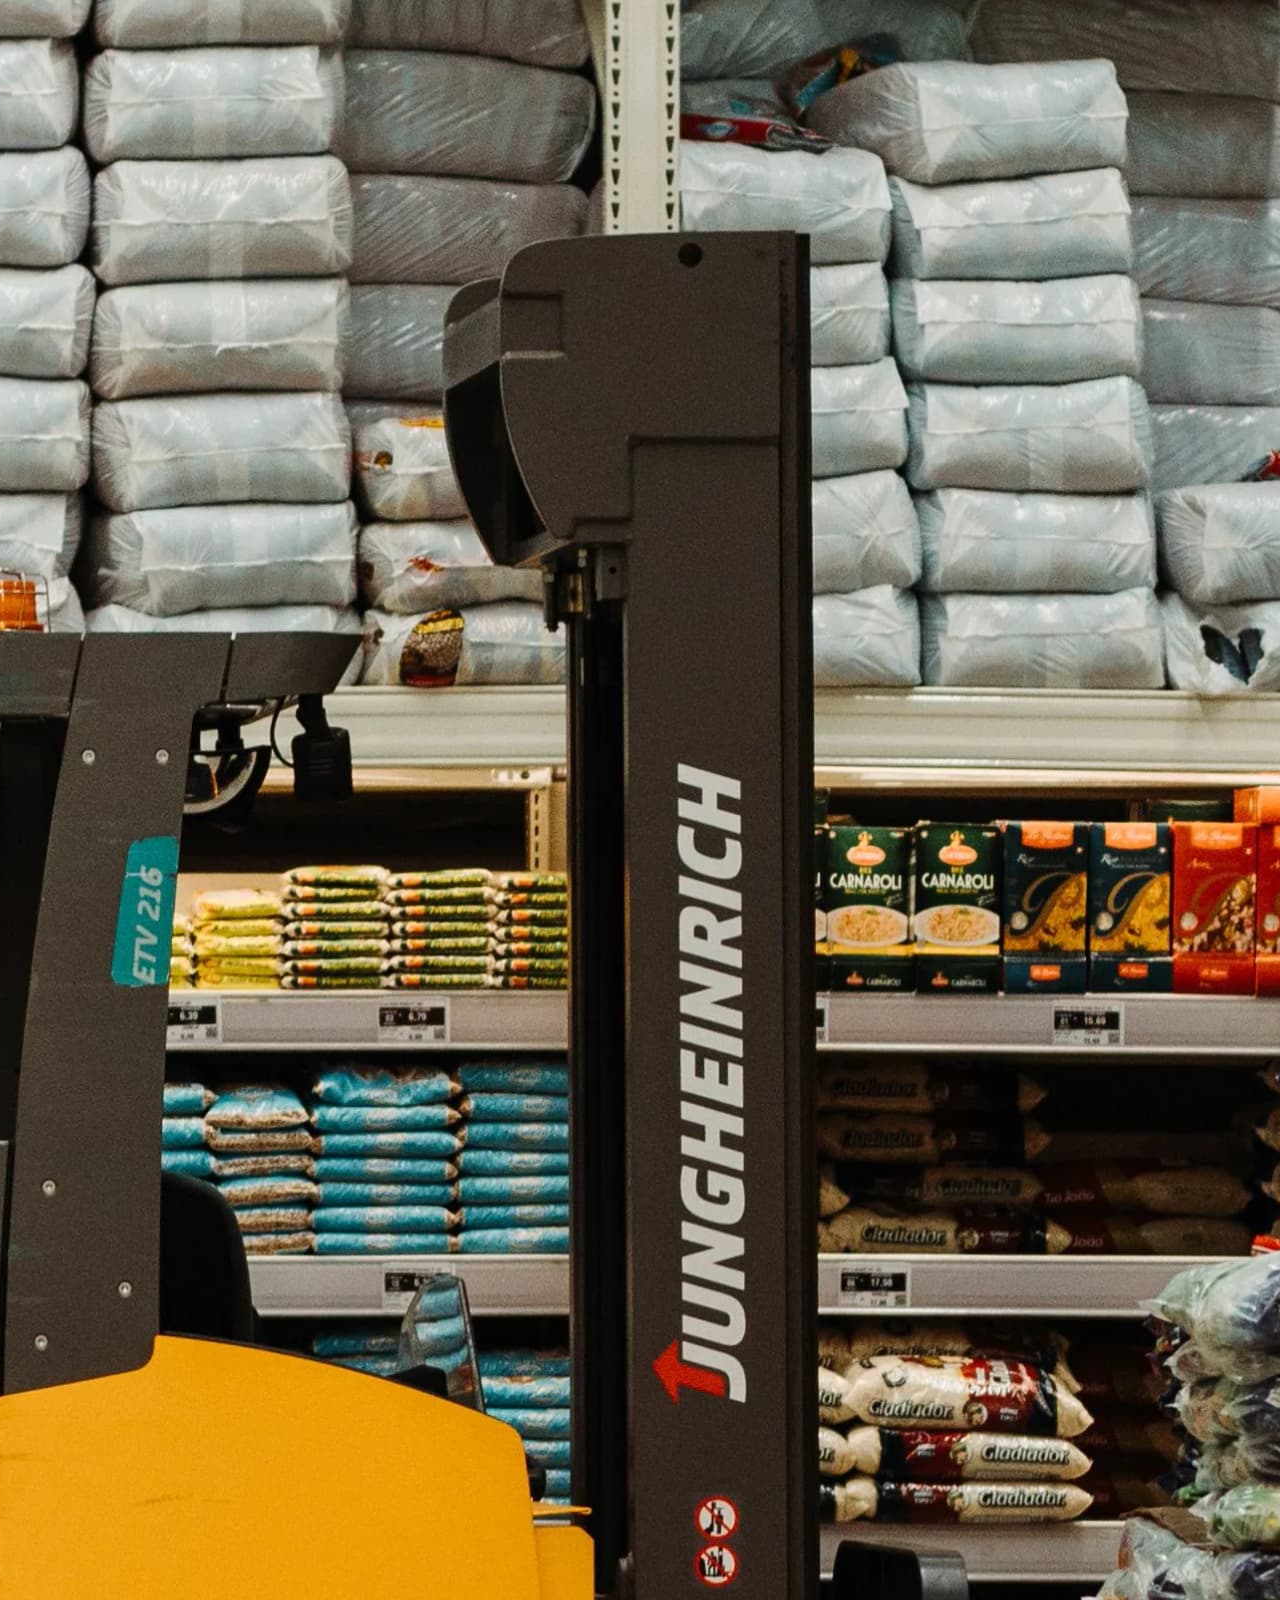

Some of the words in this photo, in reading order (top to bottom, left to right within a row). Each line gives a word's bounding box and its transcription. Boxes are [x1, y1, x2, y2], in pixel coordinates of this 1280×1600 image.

[136, 864, 163, 923] 216
[830, 873, 902, 890] CARNAROLI
[921, 872, 994, 890] CARNAROLI
[132, 924, 159, 986] ETV
[677, 762, 748, 1404] JUNGHEINRICH
